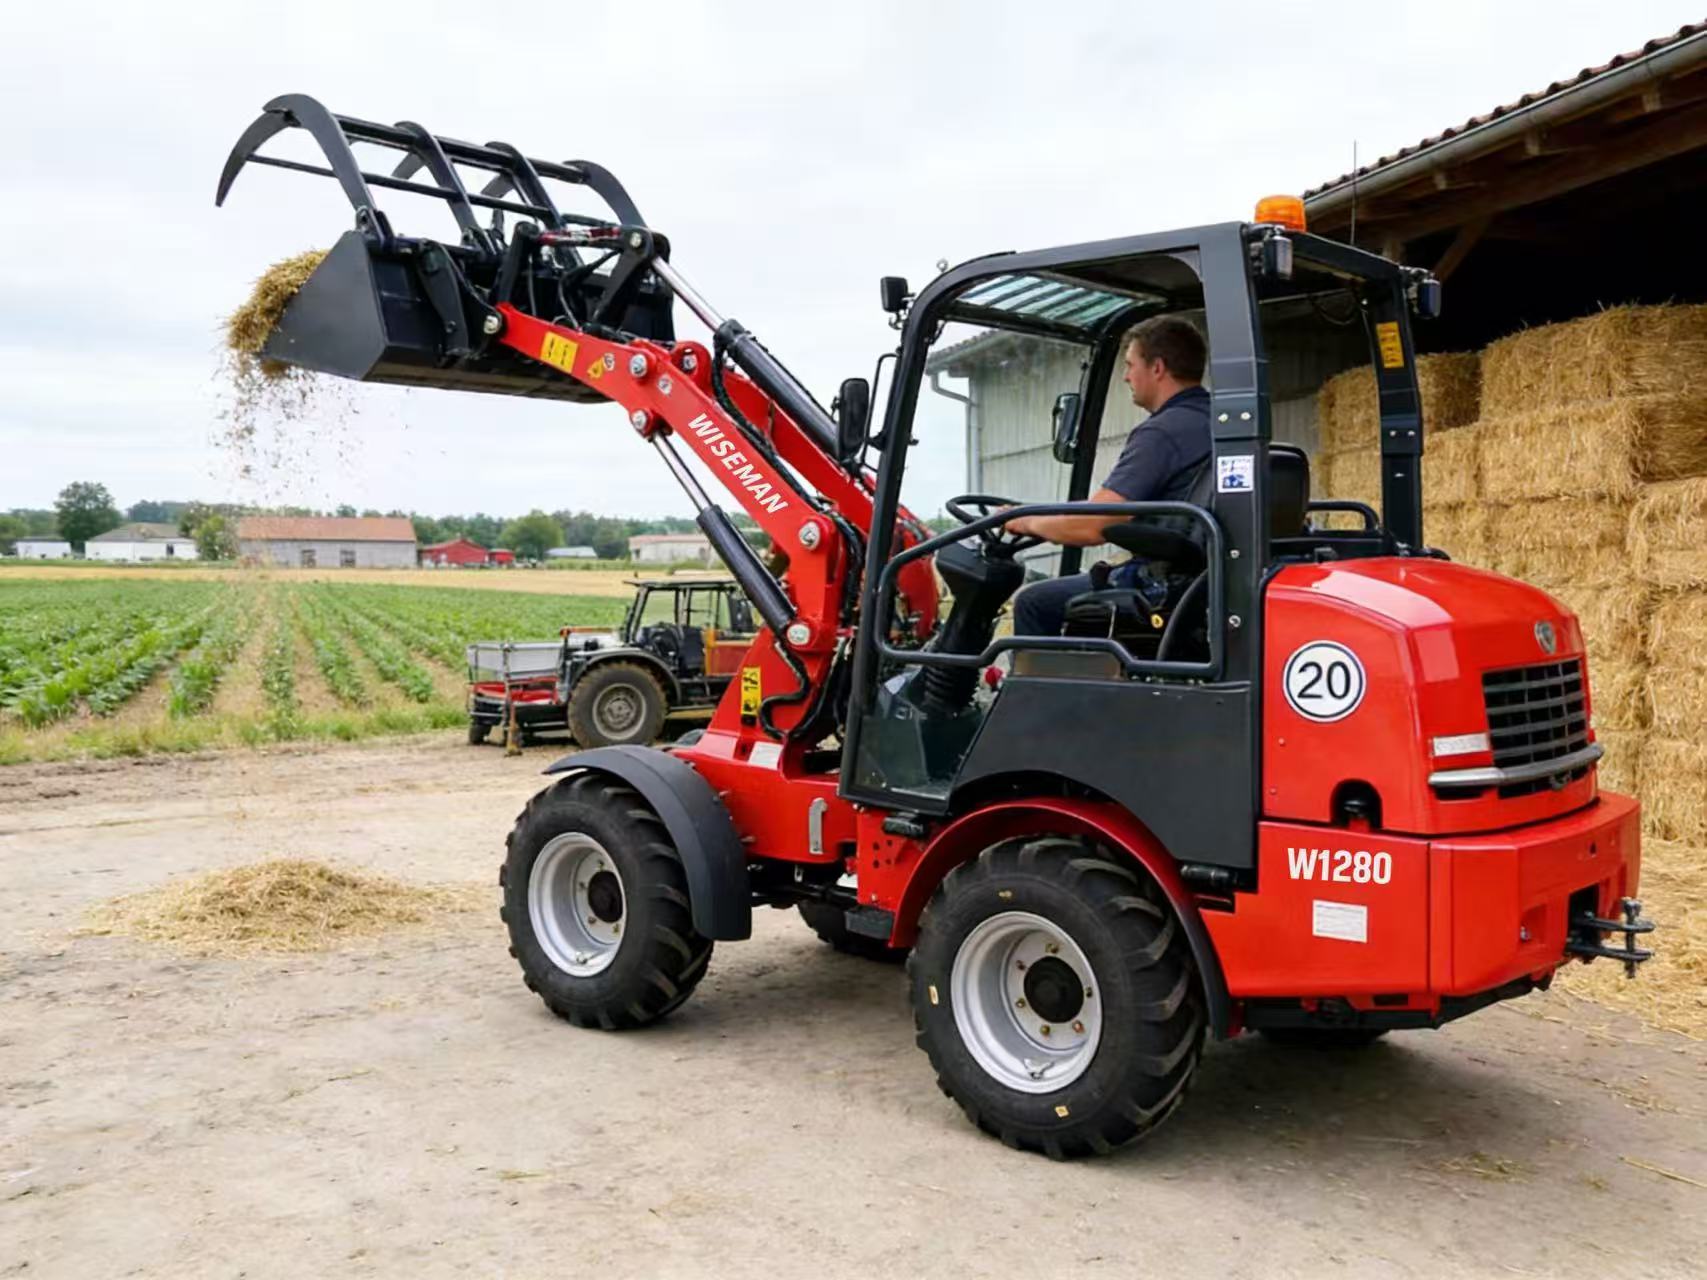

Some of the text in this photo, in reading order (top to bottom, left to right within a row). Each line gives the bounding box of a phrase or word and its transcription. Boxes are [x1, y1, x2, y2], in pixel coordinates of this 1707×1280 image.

[688, 413, 788, 513] WISEMAN
[1297, 661, 1351, 699] 20
[1288, 848, 1392, 884] W1280
